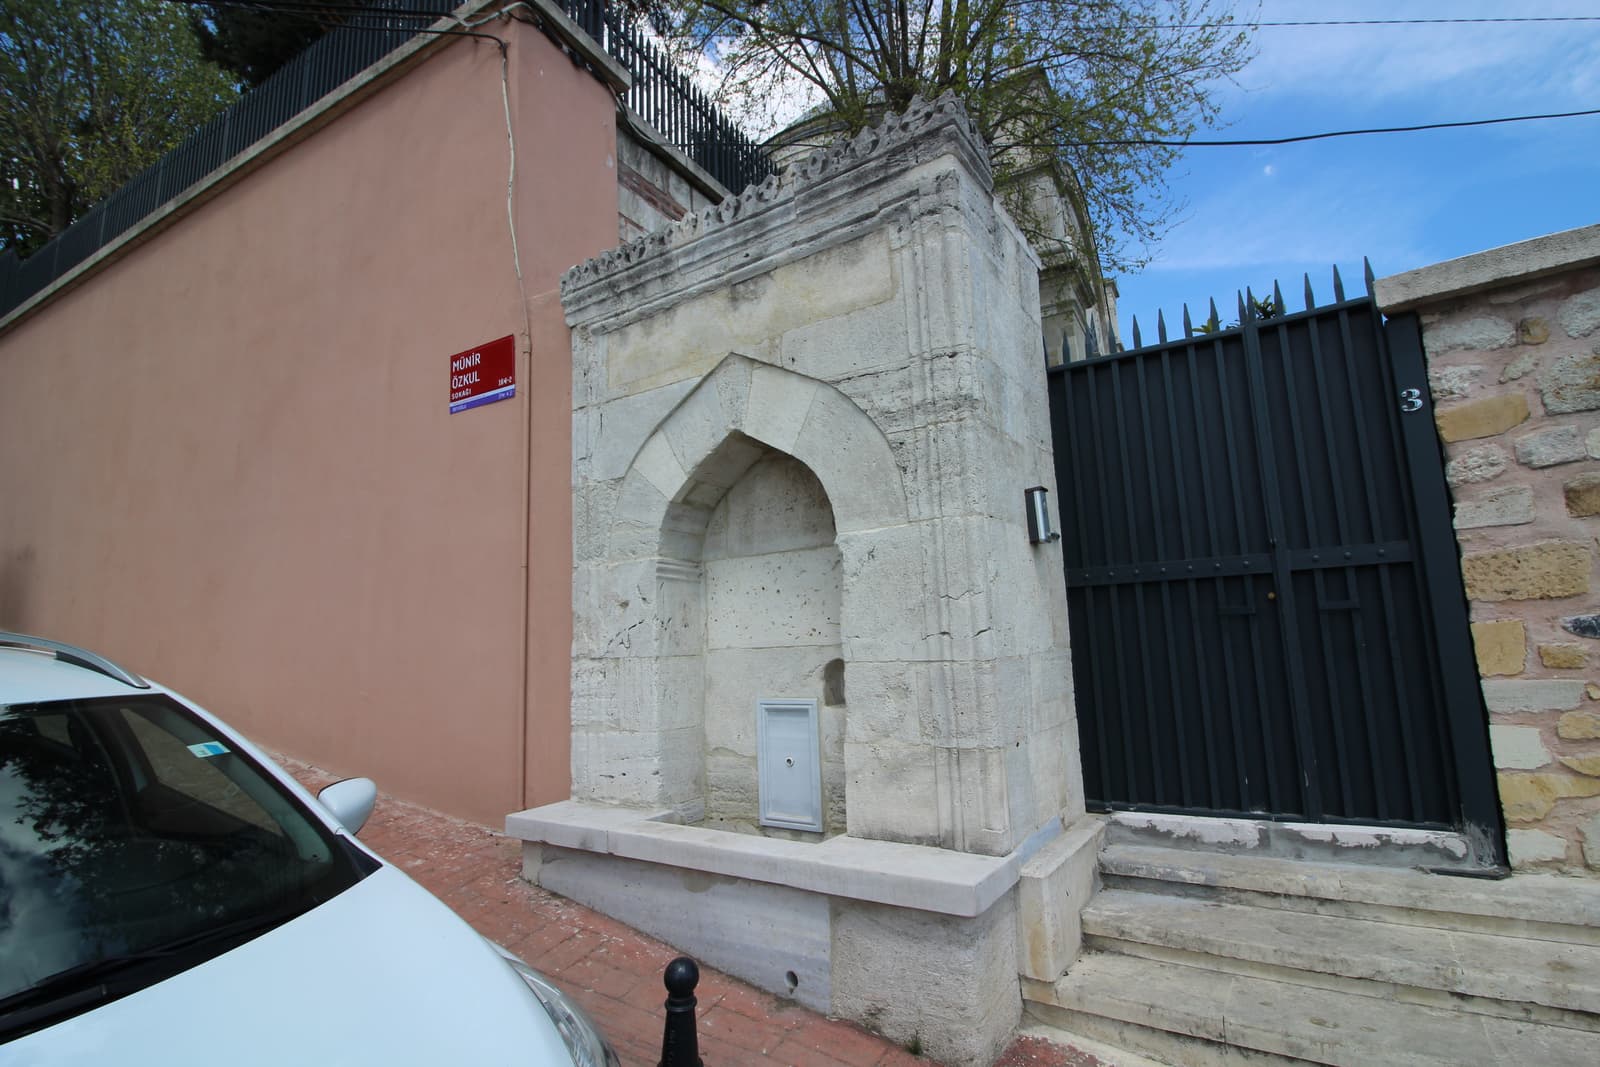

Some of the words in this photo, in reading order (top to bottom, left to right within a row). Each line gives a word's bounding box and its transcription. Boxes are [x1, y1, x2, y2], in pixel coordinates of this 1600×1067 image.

[452, 353, 480, 373] MÜNİR
[452, 371, 480, 389] ÖZKUL
[451, 388, 472, 400] SOKAĞI
[1401, 388, 1423, 412] 3
